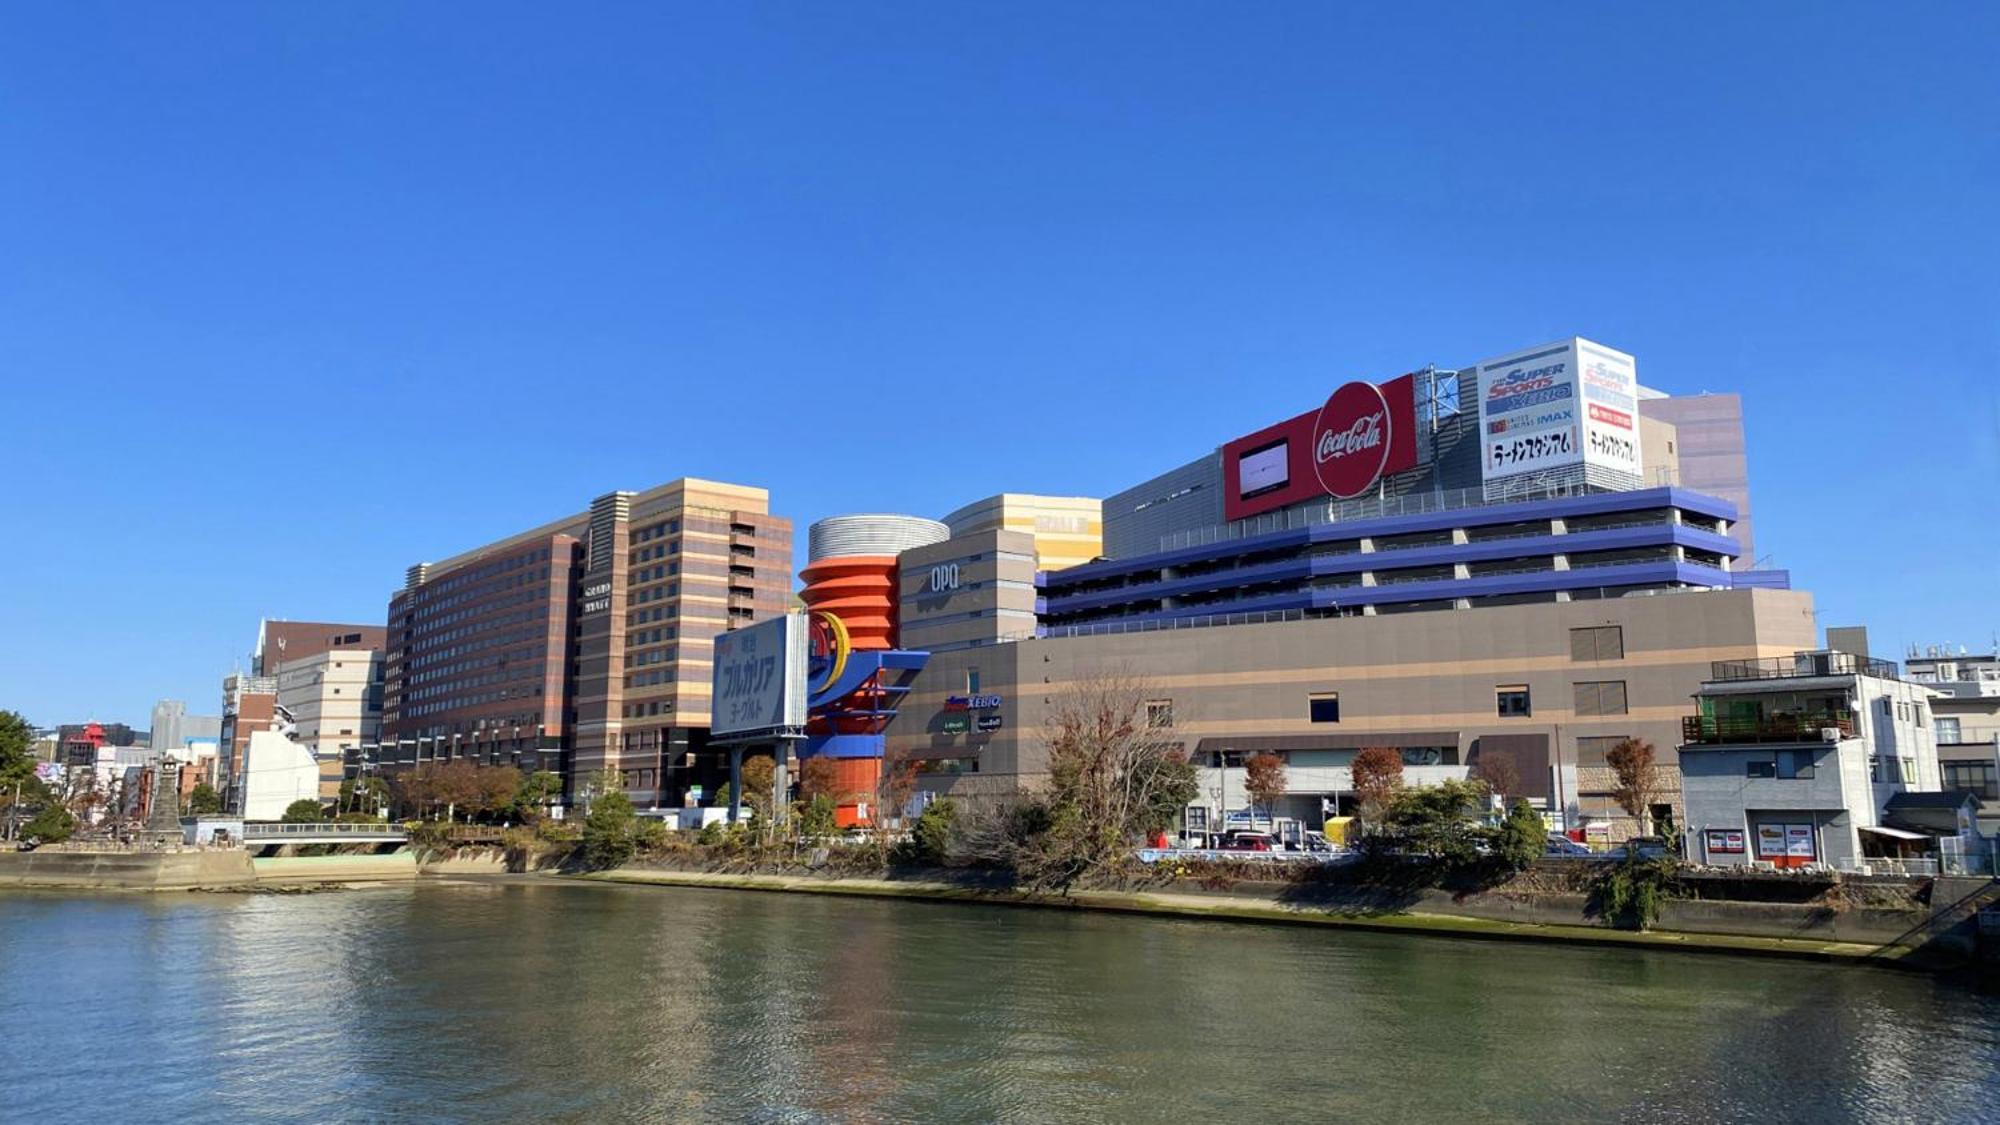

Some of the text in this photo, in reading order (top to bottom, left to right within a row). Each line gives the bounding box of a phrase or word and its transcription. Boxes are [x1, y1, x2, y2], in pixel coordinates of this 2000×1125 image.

[1505, 362, 1565, 385] SUPER
[1487, 378, 1553, 399] SPORTS
[1536, 409, 1572, 425] IMAX
[1317, 410, 1384, 463] Coca-Cola
[1494, 431, 1570, 467] ラーメンスタジアム
[931, 563, 959, 593] OPA
[722, 655, 776, 699] ブルガリア
[730, 699, 762, 723] ヨーグルト
[967, 695, 1001, 709] XEBIO
